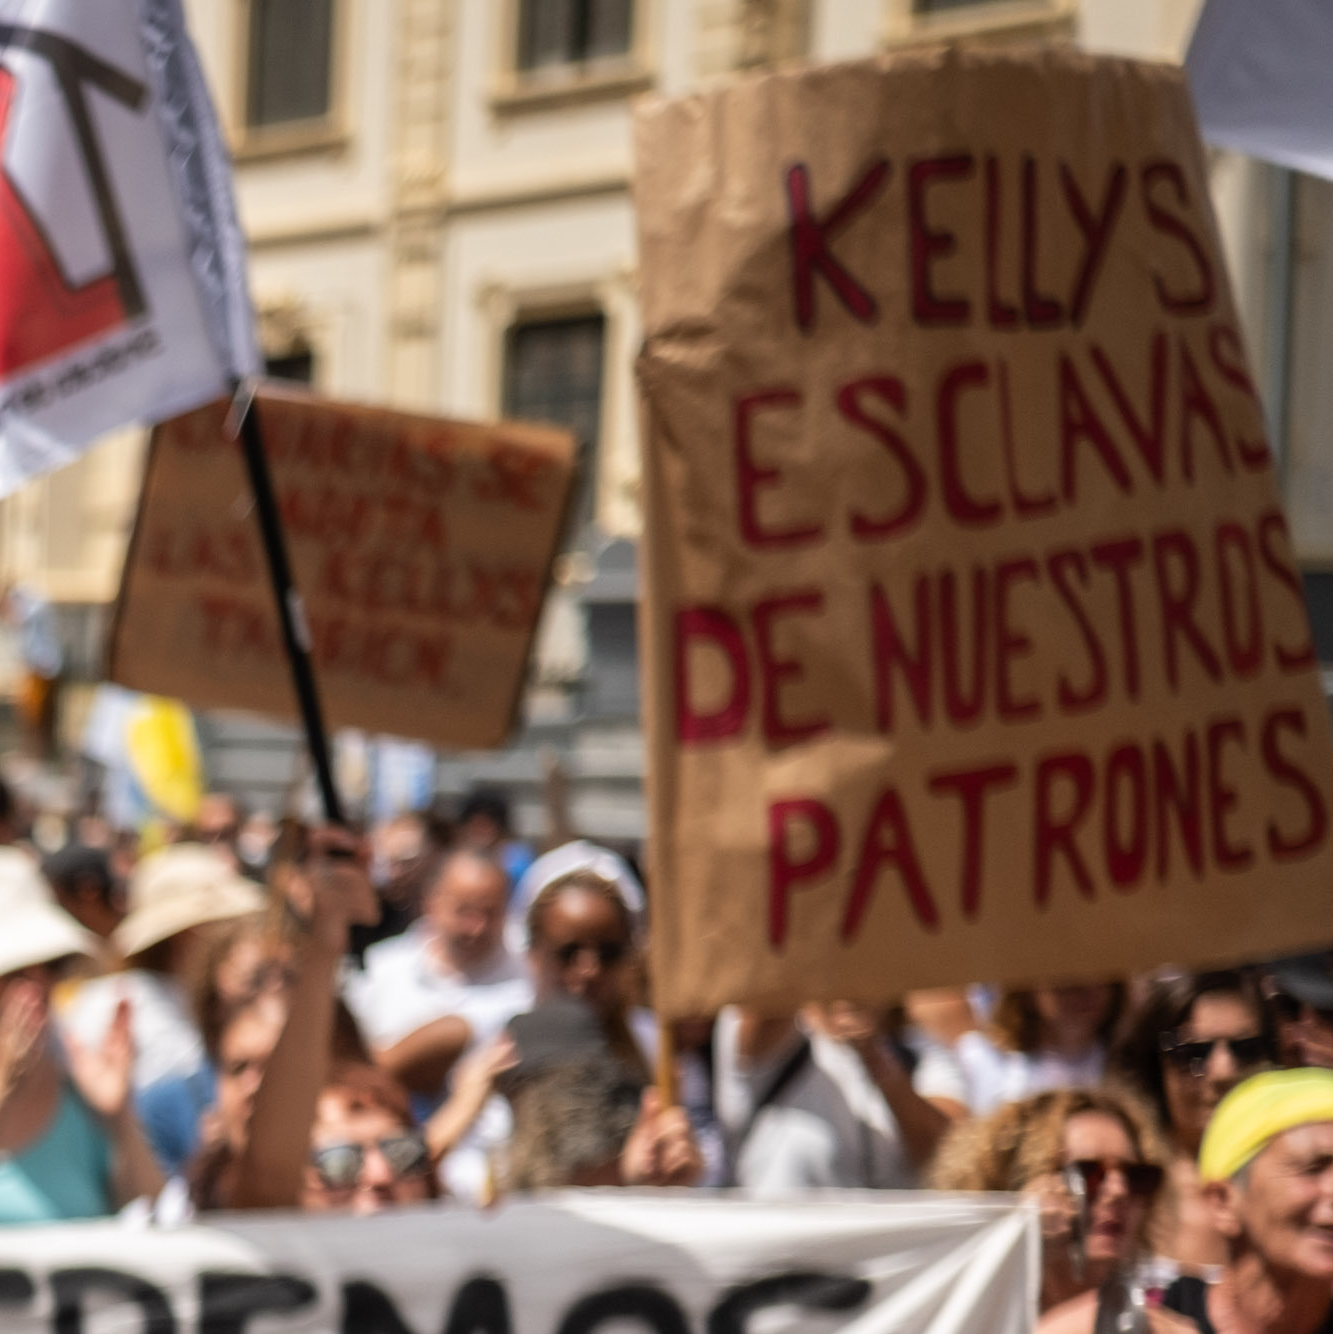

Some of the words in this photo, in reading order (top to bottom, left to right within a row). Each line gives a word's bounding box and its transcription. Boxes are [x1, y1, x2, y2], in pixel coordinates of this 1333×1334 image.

[785, 153, 1216, 334] KELLYS
[736, 325, 1273, 550] ESCLAVAS
[675, 594, 832, 747] DE
[871, 508, 1317, 735] NUESTROS
[767, 708, 1329, 950] PATRONES
